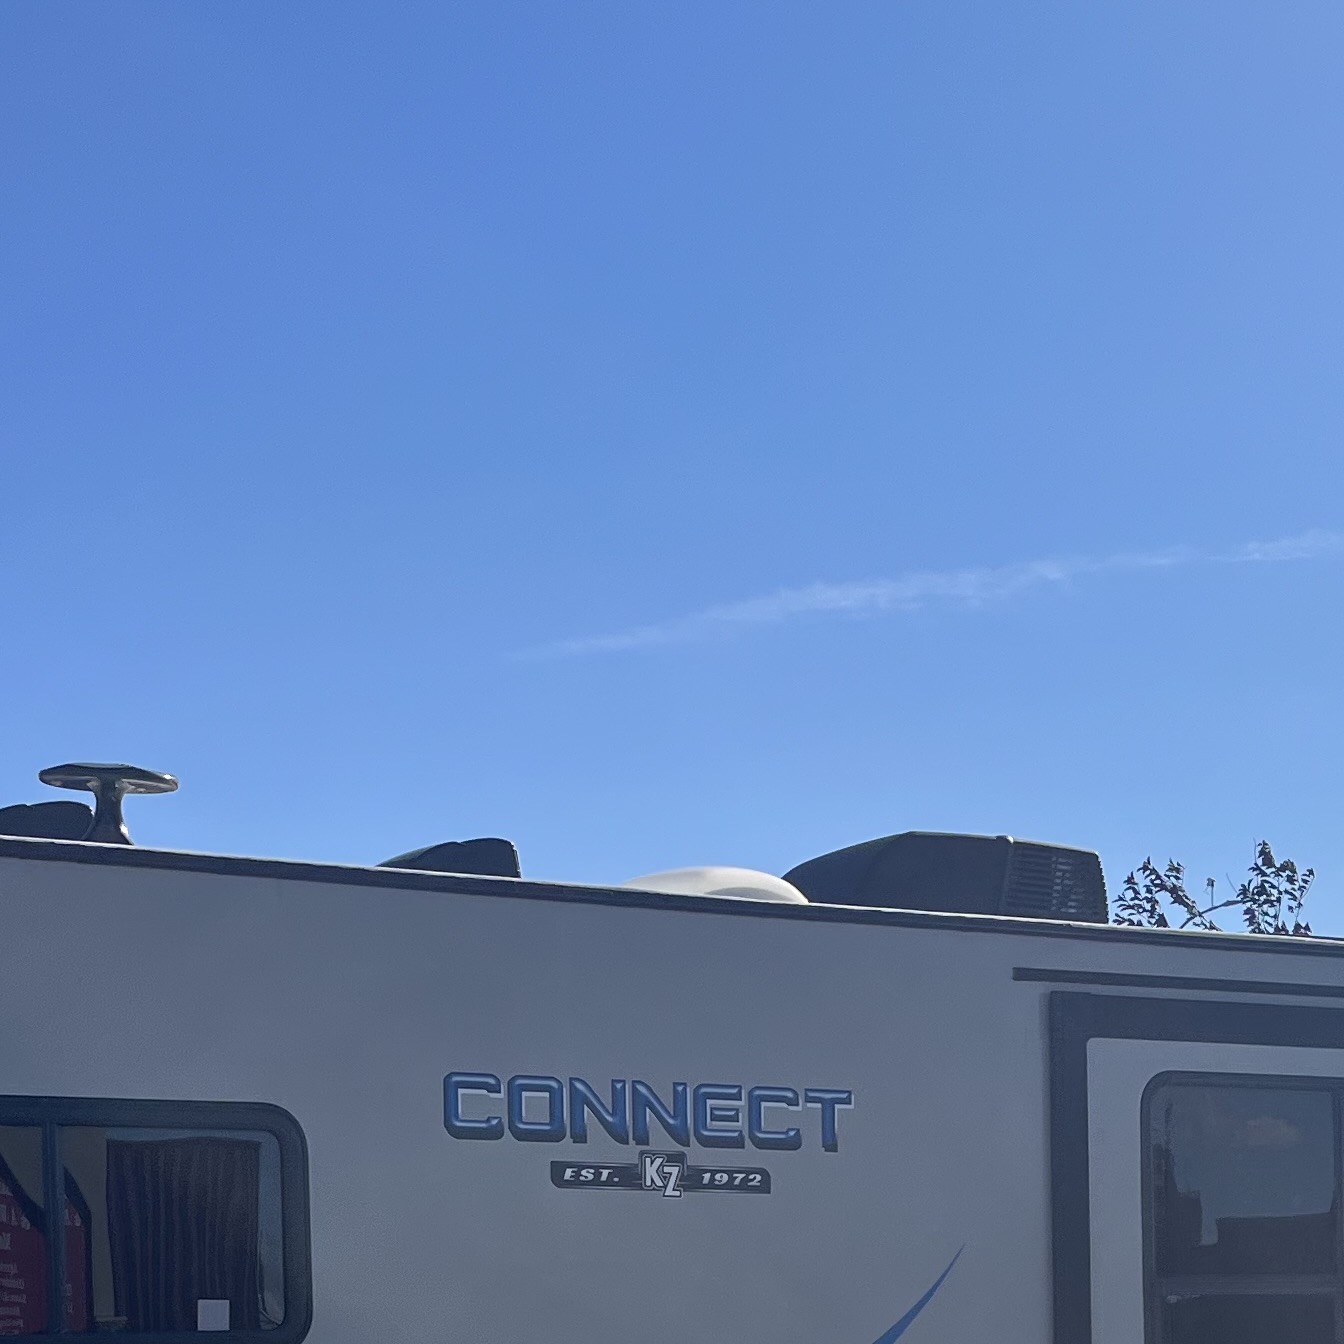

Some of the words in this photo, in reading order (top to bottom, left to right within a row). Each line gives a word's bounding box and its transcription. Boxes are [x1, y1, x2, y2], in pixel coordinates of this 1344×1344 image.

[443, 1071, 854, 1153] CONNECT
[563, 1167, 620, 1182] EST.
[642, 1153, 683, 1198] KZ
[701, 1171, 763, 1187] 1972
